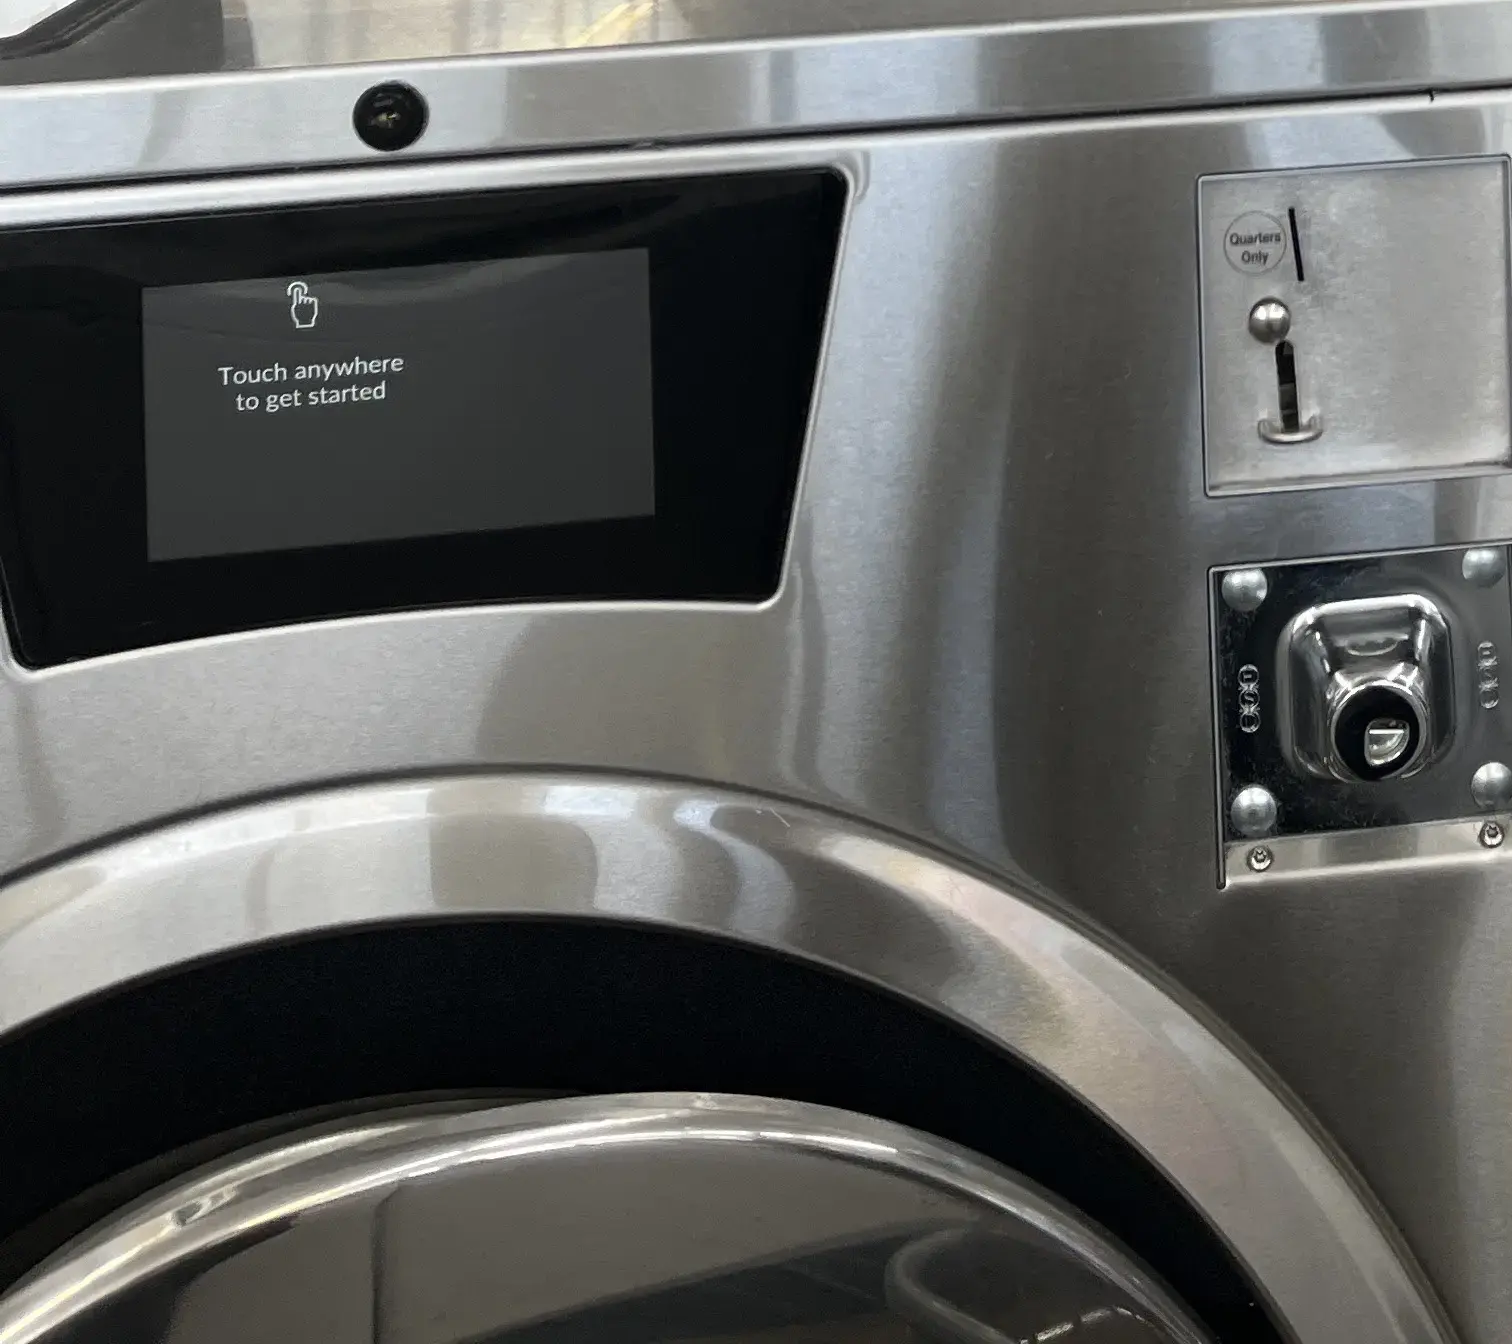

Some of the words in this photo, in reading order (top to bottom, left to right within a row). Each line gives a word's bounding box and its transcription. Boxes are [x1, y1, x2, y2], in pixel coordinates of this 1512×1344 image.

[1229, 231, 1281, 245] Quarters
[1240, 249, 1269, 266] Only
[218, 362, 288, 385] Touch
[294, 354, 404, 383] anywhere
[235, 390, 259, 412] to
[265, 387, 302, 413] get
[308, 380, 387, 406] started
